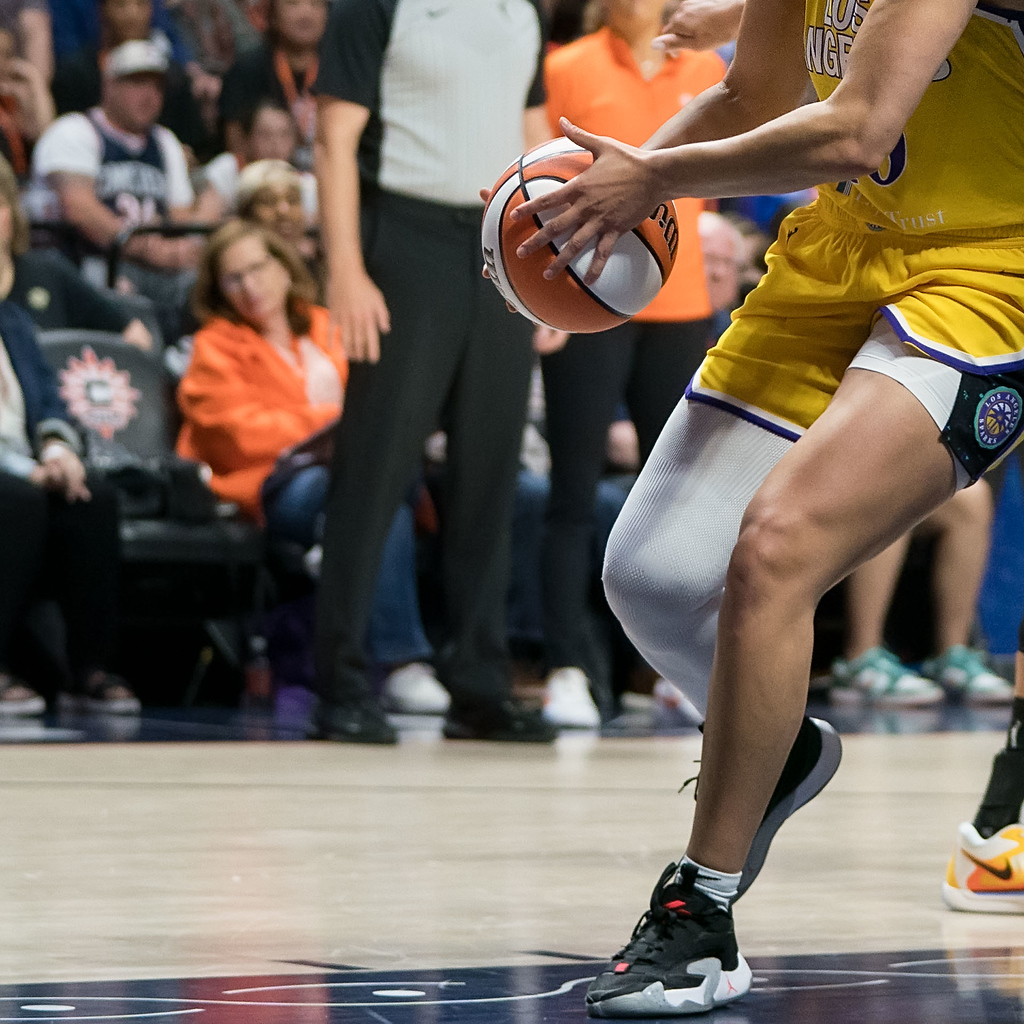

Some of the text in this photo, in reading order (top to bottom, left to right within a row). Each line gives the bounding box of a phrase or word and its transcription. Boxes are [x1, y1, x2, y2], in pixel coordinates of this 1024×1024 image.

[985, 393, 1020, 434] LOS ANGELES
[979, 418, 998, 444] SPARKS
